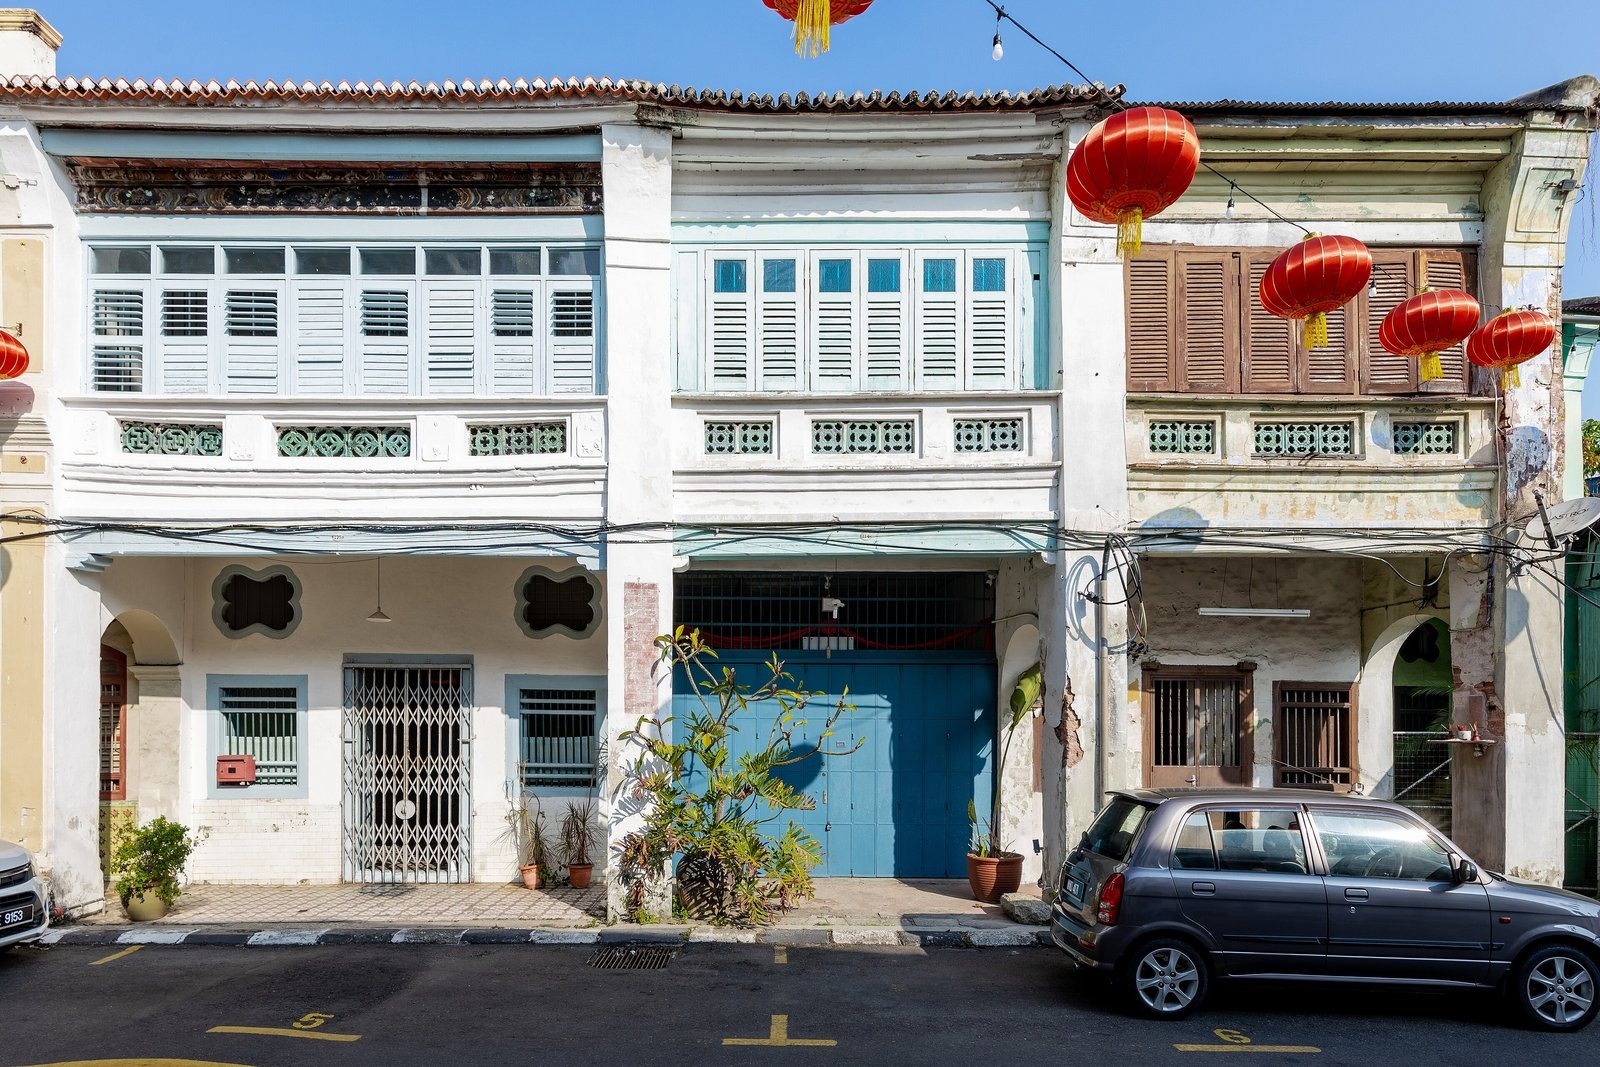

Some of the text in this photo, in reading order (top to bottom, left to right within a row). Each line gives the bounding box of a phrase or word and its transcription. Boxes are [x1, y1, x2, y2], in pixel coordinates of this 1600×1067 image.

[4, 910, 24, 924] 9153
[292, 1012, 335, 1029] 5
[1213, 1028, 1251, 1044] 6
